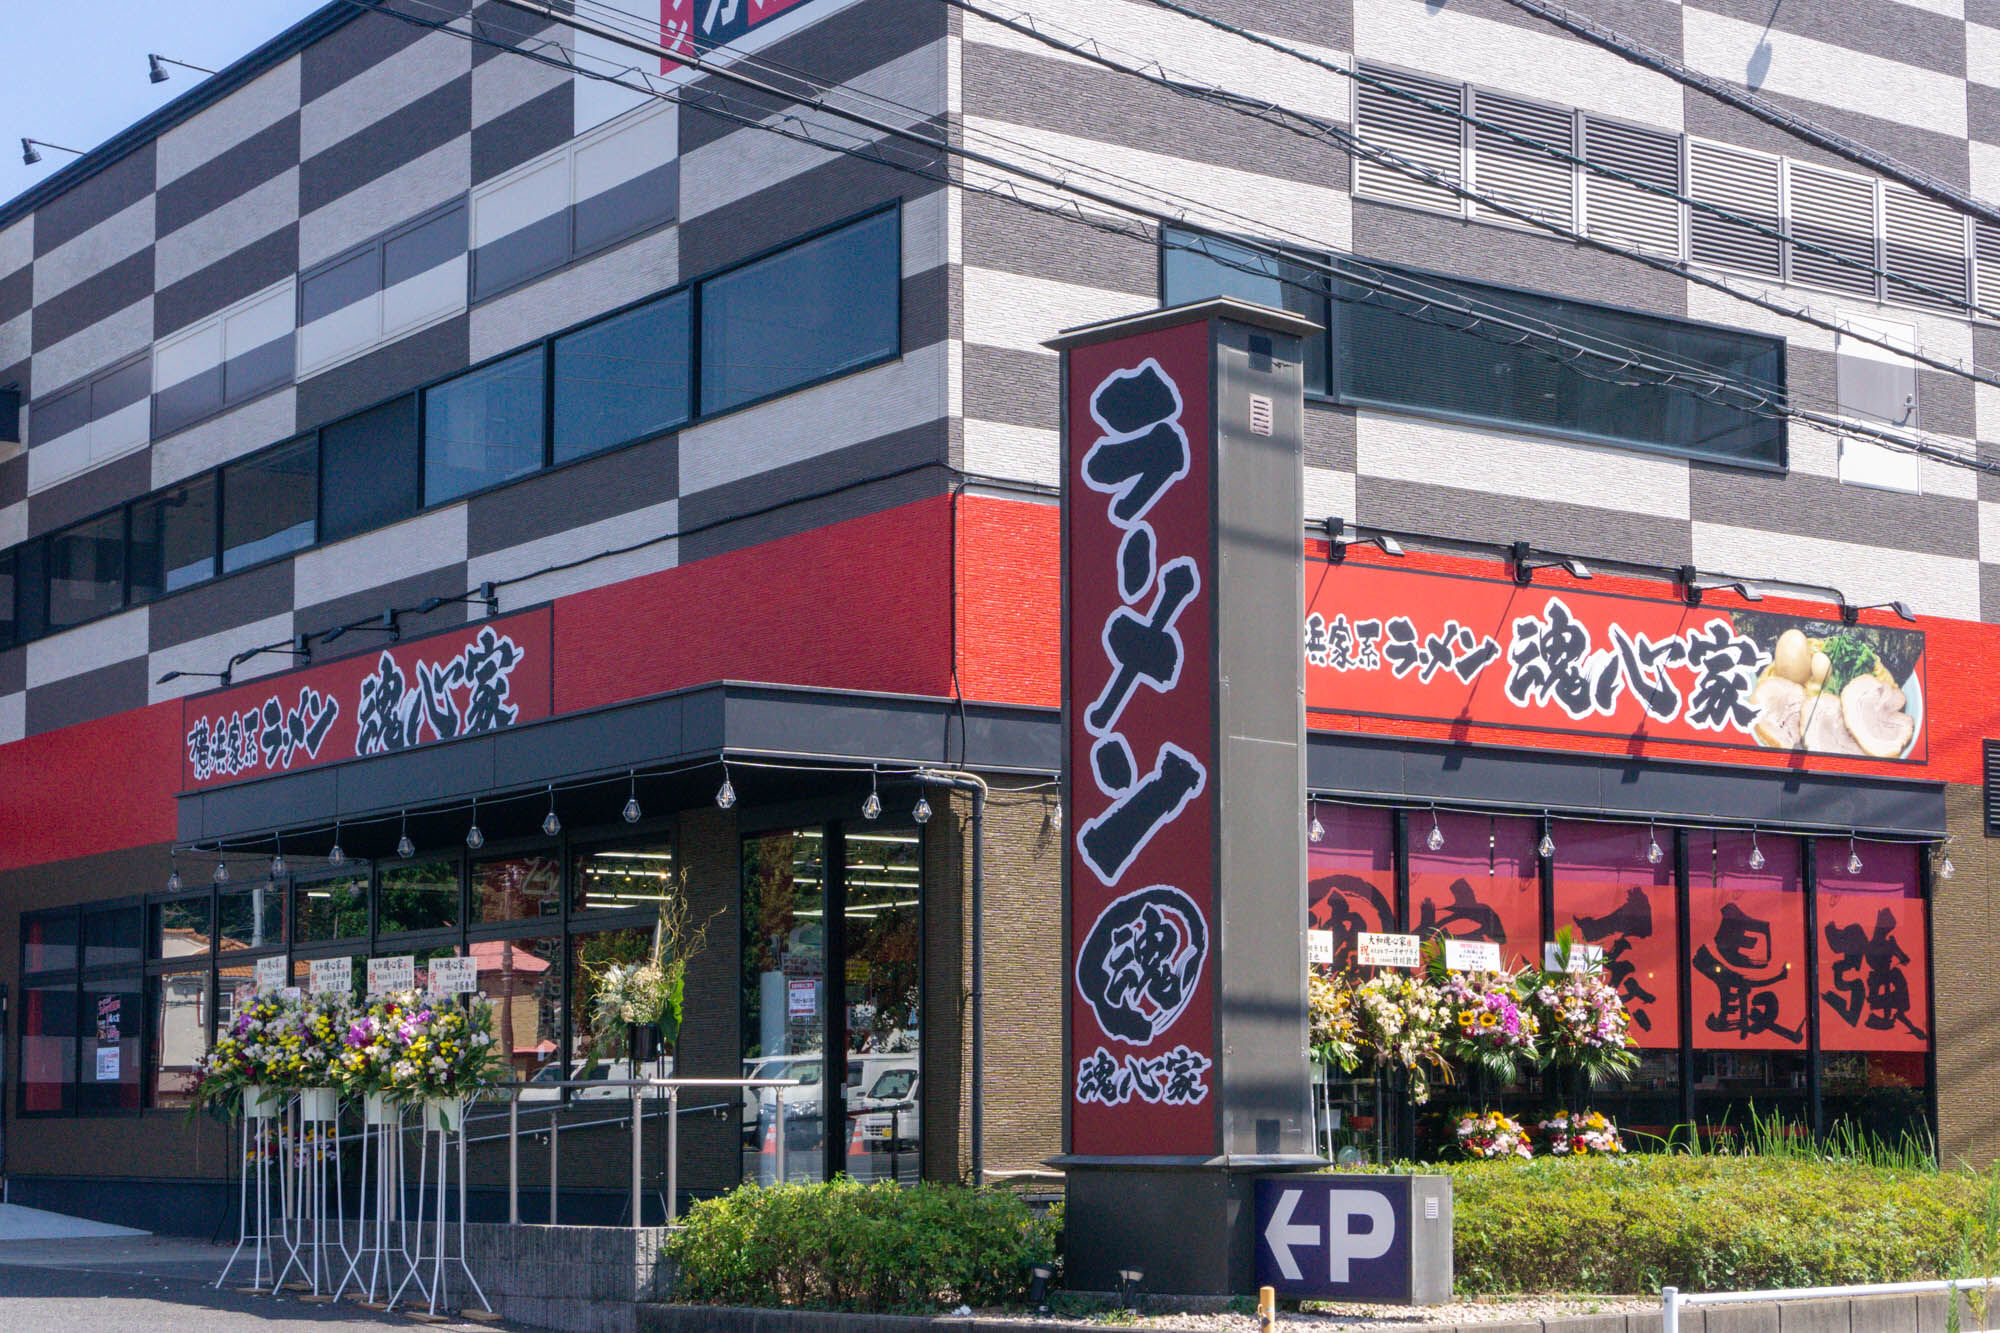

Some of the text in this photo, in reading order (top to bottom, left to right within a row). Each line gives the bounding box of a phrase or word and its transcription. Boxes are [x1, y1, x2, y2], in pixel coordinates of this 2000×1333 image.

[1077, 357, 1207, 887] ラーメン
[1504, 596, 1773, 733] 魂心家
[356, 625, 525, 758] 魂心家
[1077, 1045, 1212, 1107] 魂心家
[1330, 1189, 1395, 1282] P
